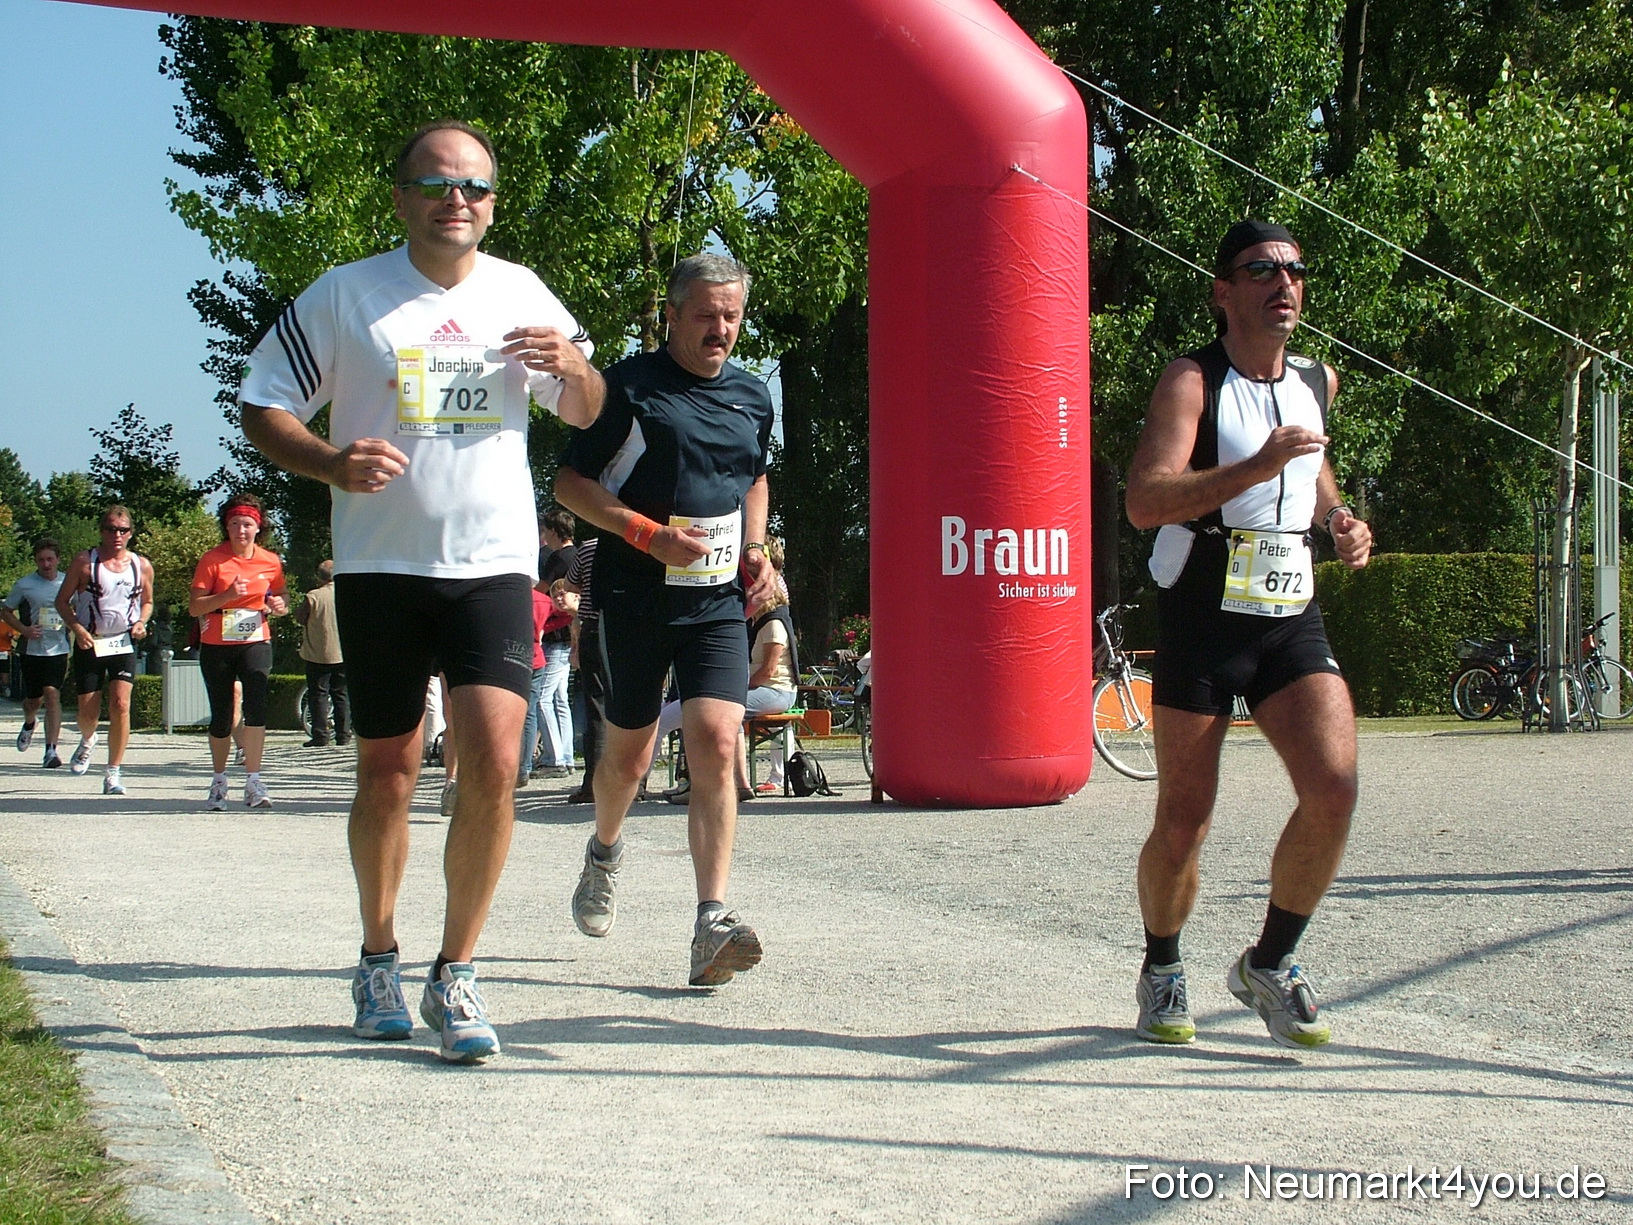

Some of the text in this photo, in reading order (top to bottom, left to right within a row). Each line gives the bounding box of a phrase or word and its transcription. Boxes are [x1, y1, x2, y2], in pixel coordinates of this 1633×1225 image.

[430, 334, 471, 342] adidas
[429, 356, 484, 373] Joachim
[403, 382, 410, 394] C
[440, 388, 488, 411] 702
[1058, 396, 1068, 424] 1929
[693, 521, 733, 539] egfried
[941, 515, 1070, 576] Braun
[1259, 540, 1291, 557] Peter
[705, 545, 732, 566] 175
[998, 581, 1077, 599] Sicher ist sicher
[1265, 571, 1302, 593] 672
[238, 622, 257, 632] 538
